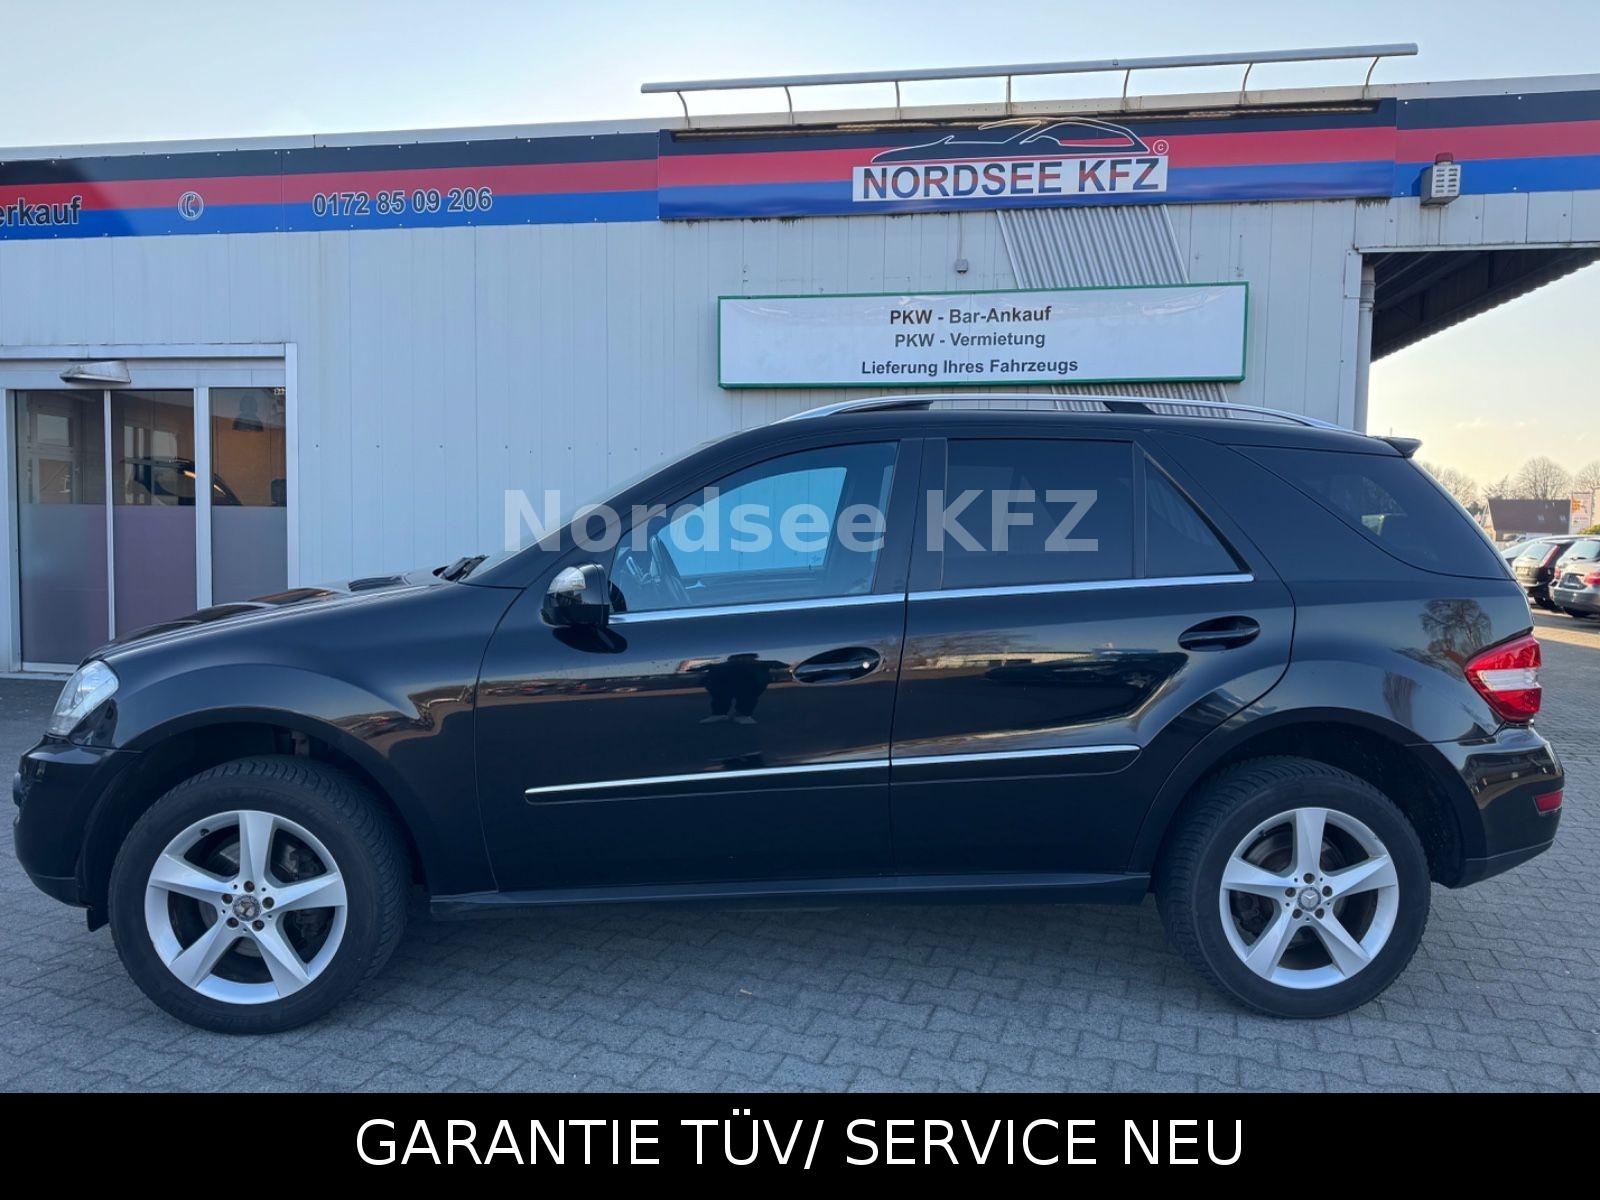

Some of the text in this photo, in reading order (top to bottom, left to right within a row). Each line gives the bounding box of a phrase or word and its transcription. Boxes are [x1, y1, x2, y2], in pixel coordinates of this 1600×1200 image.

[863, 157, 1160, 199] NORDSEE KFZ
[313, 186, 493, 217] 0172 85 09 206
[890, 309, 933, 325] PKW
[949, 305, 1052, 324] Bar-Ankauf
[895, 333, 935, 348] PKW
[949, 332, 1046, 348] Vermietung
[861, 359, 1079, 377] Lieferung Ihres Fahrzeugs
